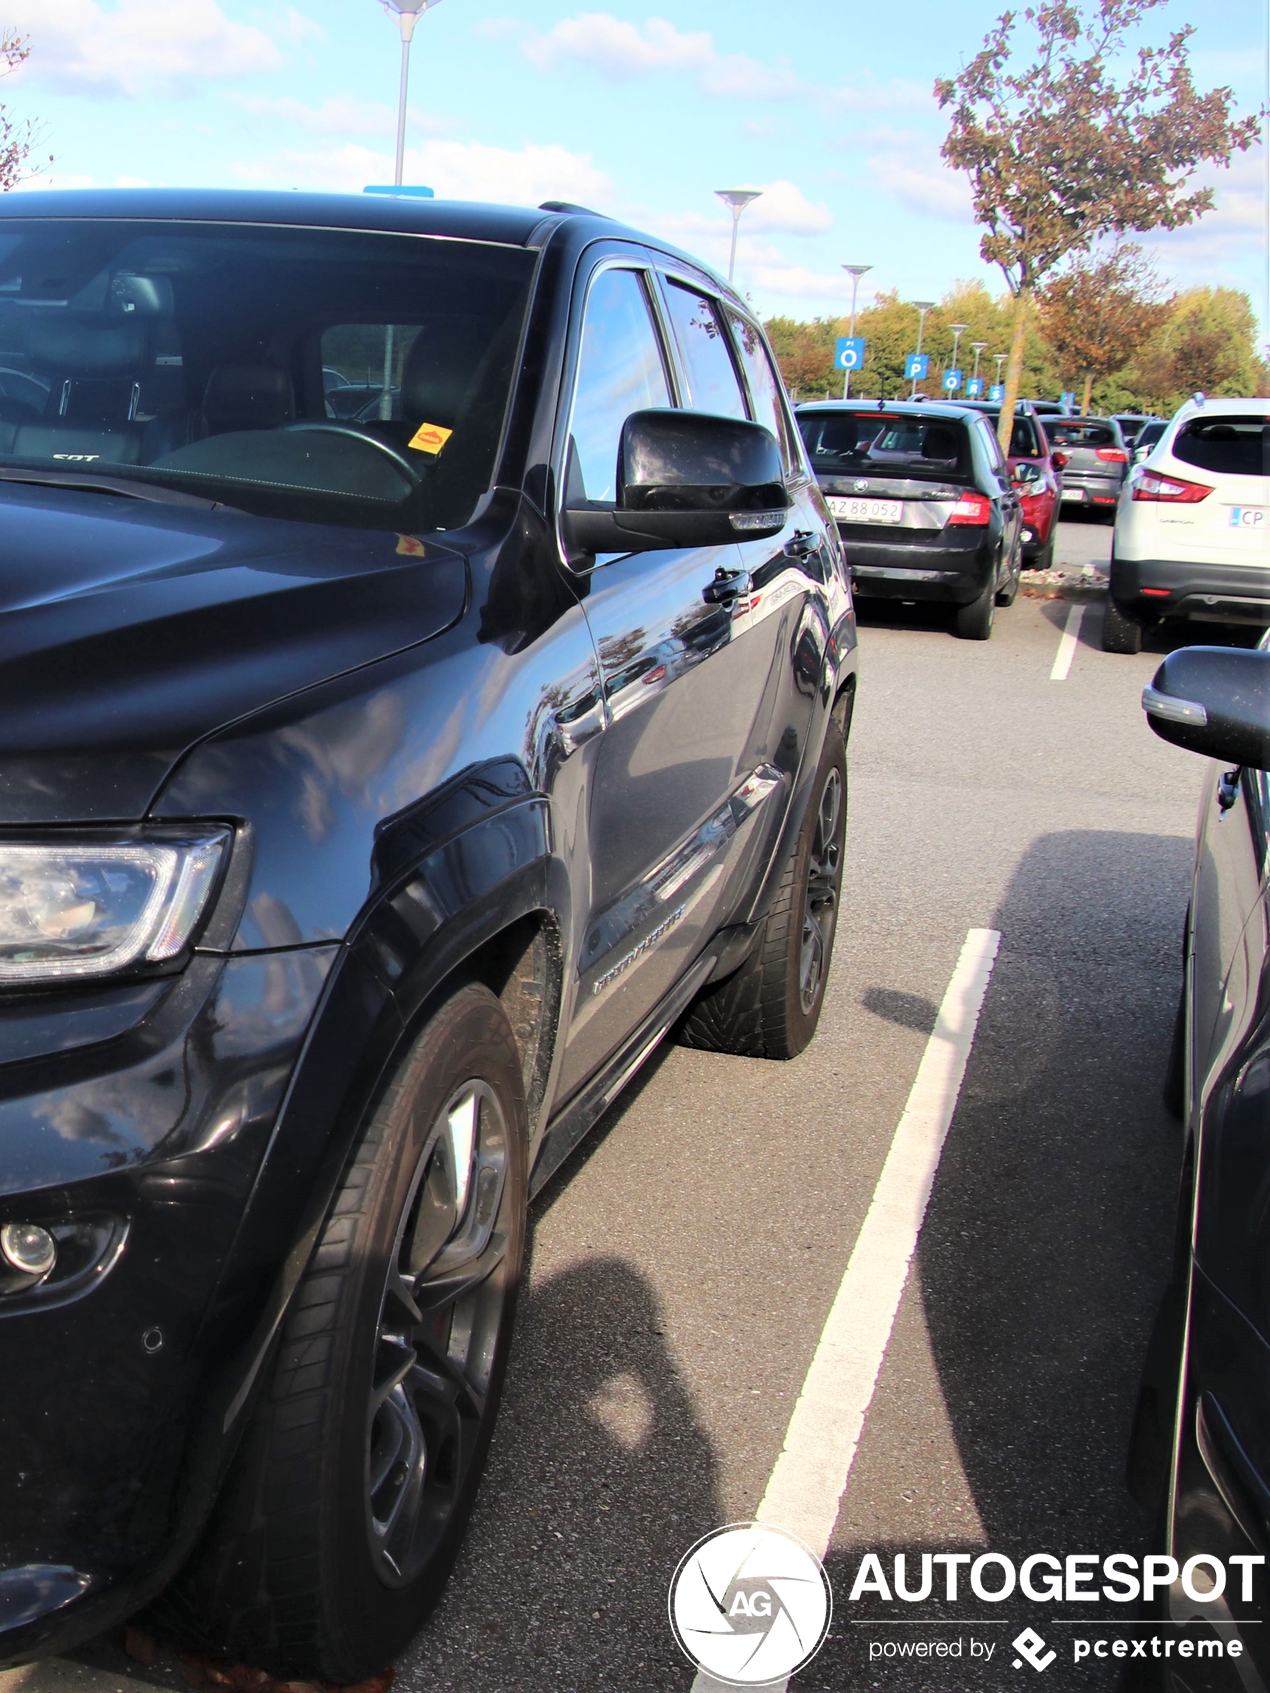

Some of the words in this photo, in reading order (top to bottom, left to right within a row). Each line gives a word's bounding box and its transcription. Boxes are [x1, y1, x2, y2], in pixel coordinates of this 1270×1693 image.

[911, 363, 922, 377] P
[850, 501, 868, 515] 88
[871, 503, 898, 517] 052
[1242, 511, 1263, 525] CP
